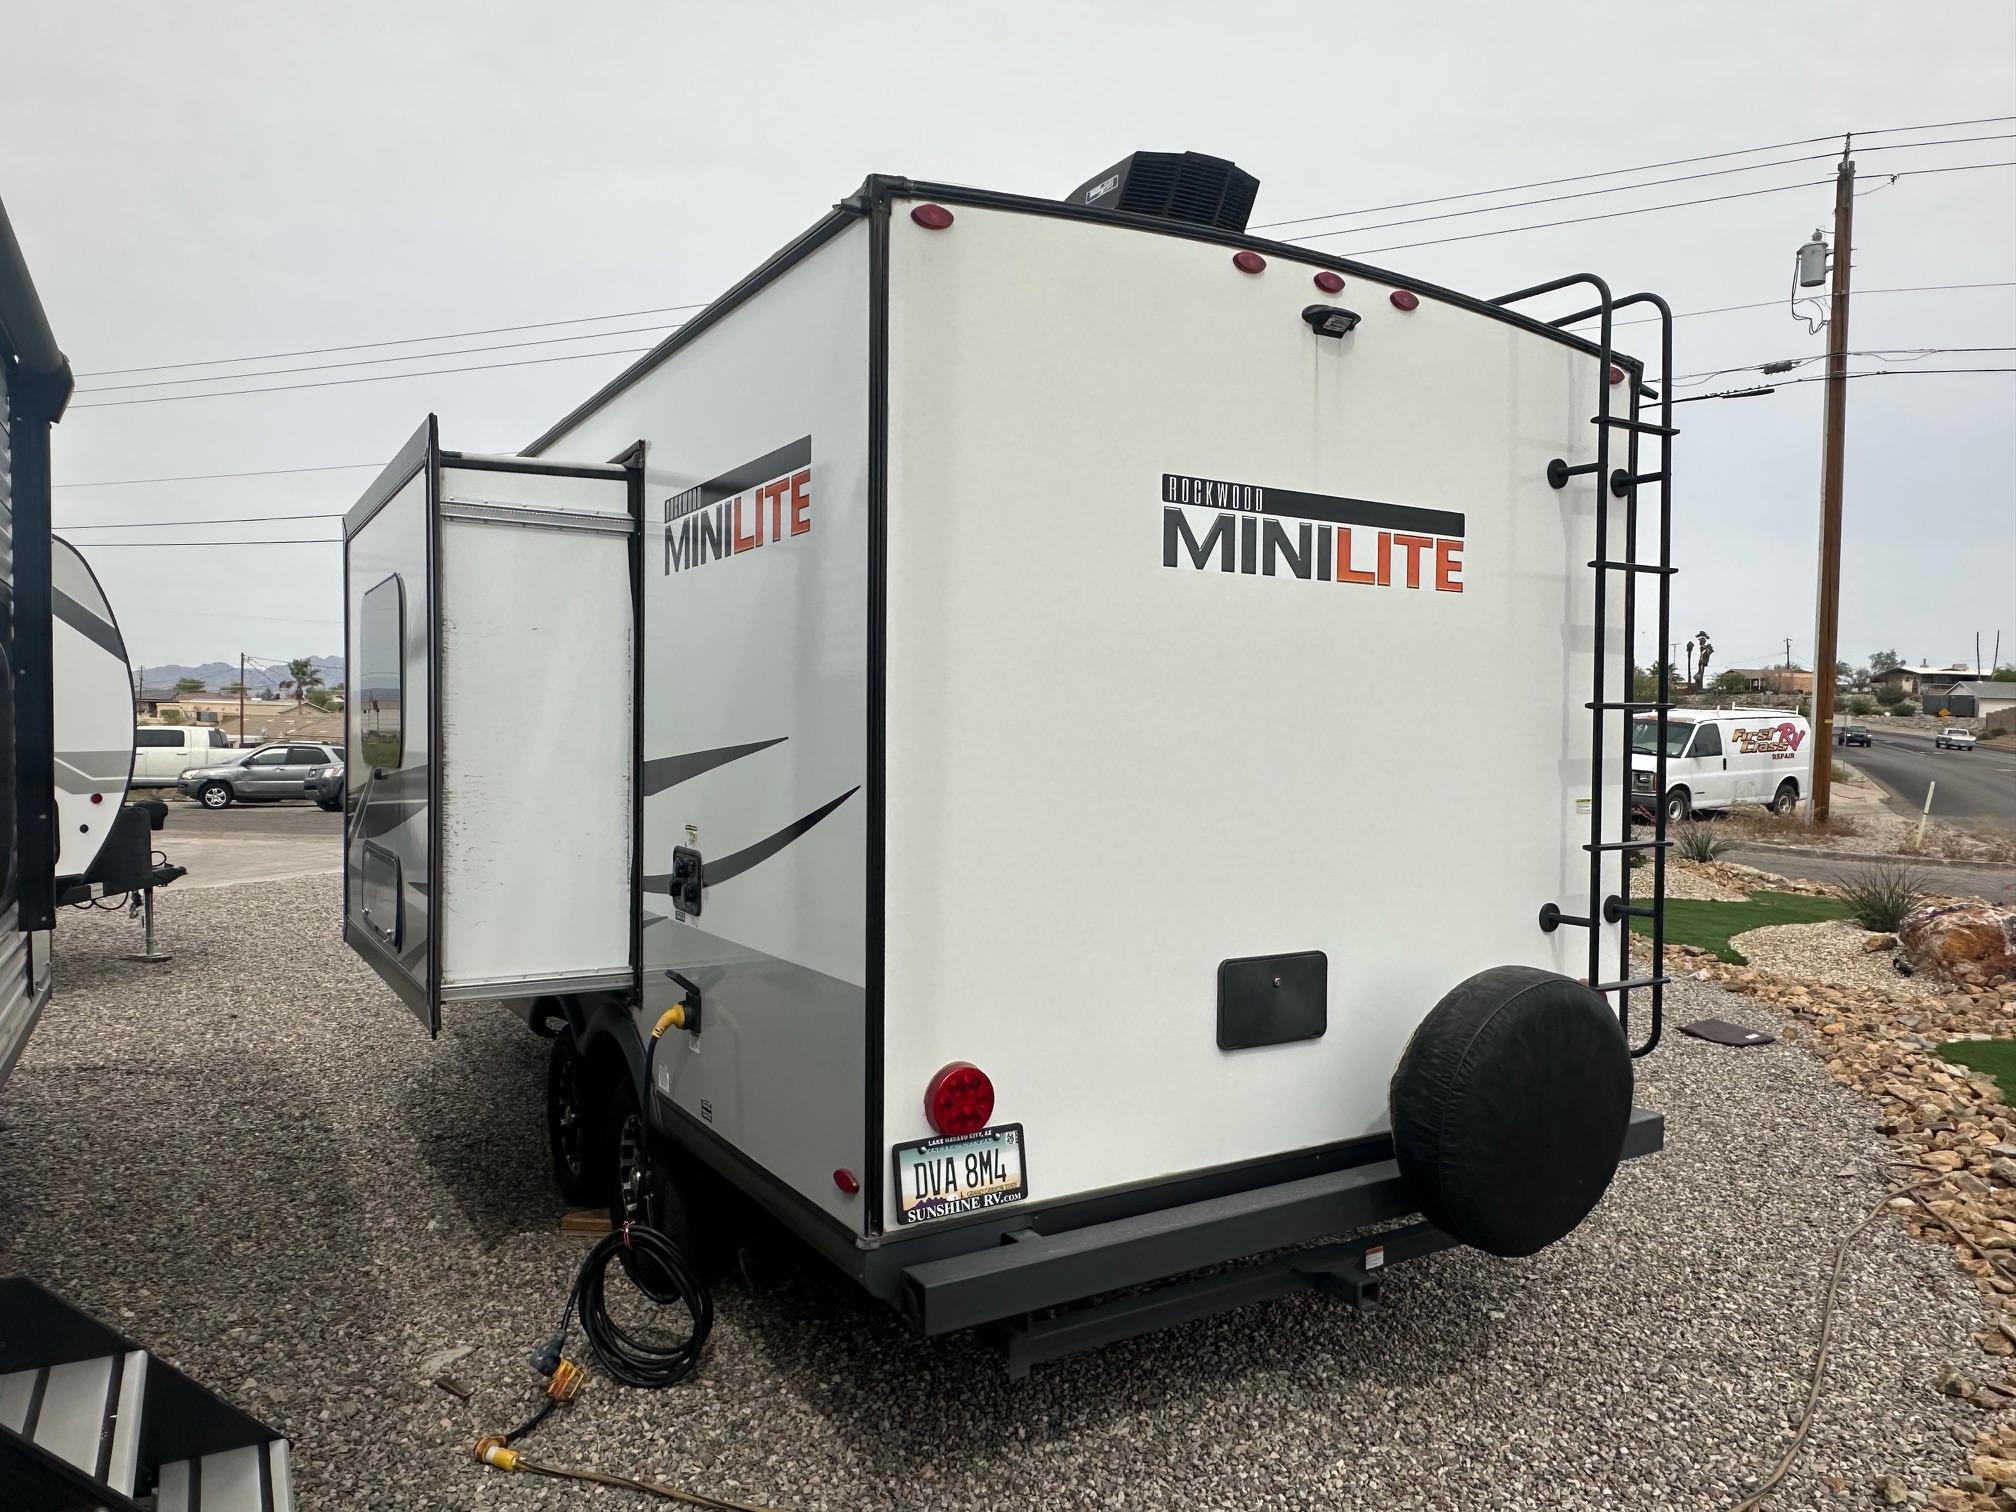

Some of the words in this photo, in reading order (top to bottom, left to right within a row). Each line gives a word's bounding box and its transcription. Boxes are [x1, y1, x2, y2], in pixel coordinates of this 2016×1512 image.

[1168, 475, 1264, 512] ROCKWOOD
[664, 468, 811, 576] MINILITE
[1162, 505, 1464, 593] MINILITE
[1777, 722, 1806, 752] RV
[928, 1138, 944, 1146] LAKE
[913, 1156, 958, 1200] DVA
[964, 1148, 1007, 1188] 8M4
[907, 1197, 980, 1223] SUNSHINE
